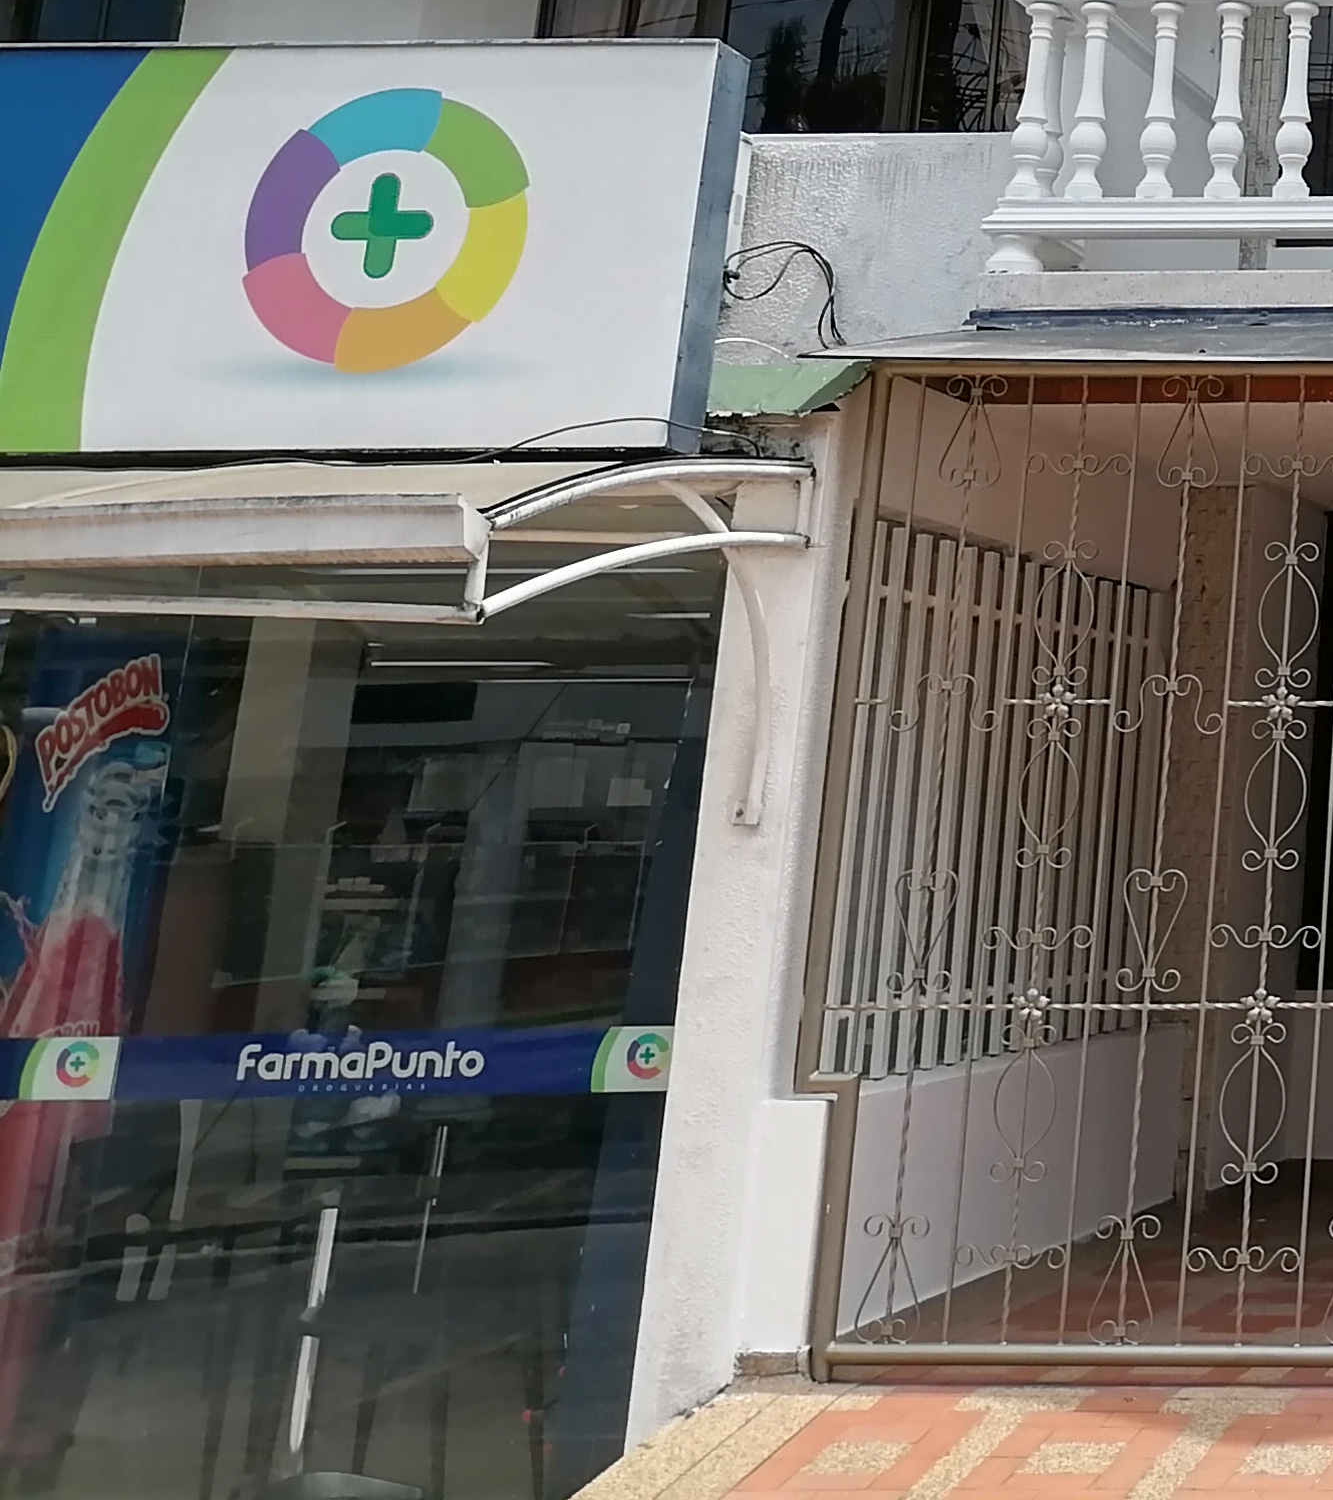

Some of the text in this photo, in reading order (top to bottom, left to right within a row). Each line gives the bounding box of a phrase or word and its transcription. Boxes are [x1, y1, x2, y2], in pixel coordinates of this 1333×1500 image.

[37, 654, 162, 783] POSTOBON
[236, 1041, 485, 1080] FarmaPunto
[298, 1083, 426, 1092] DROGUERIAS
